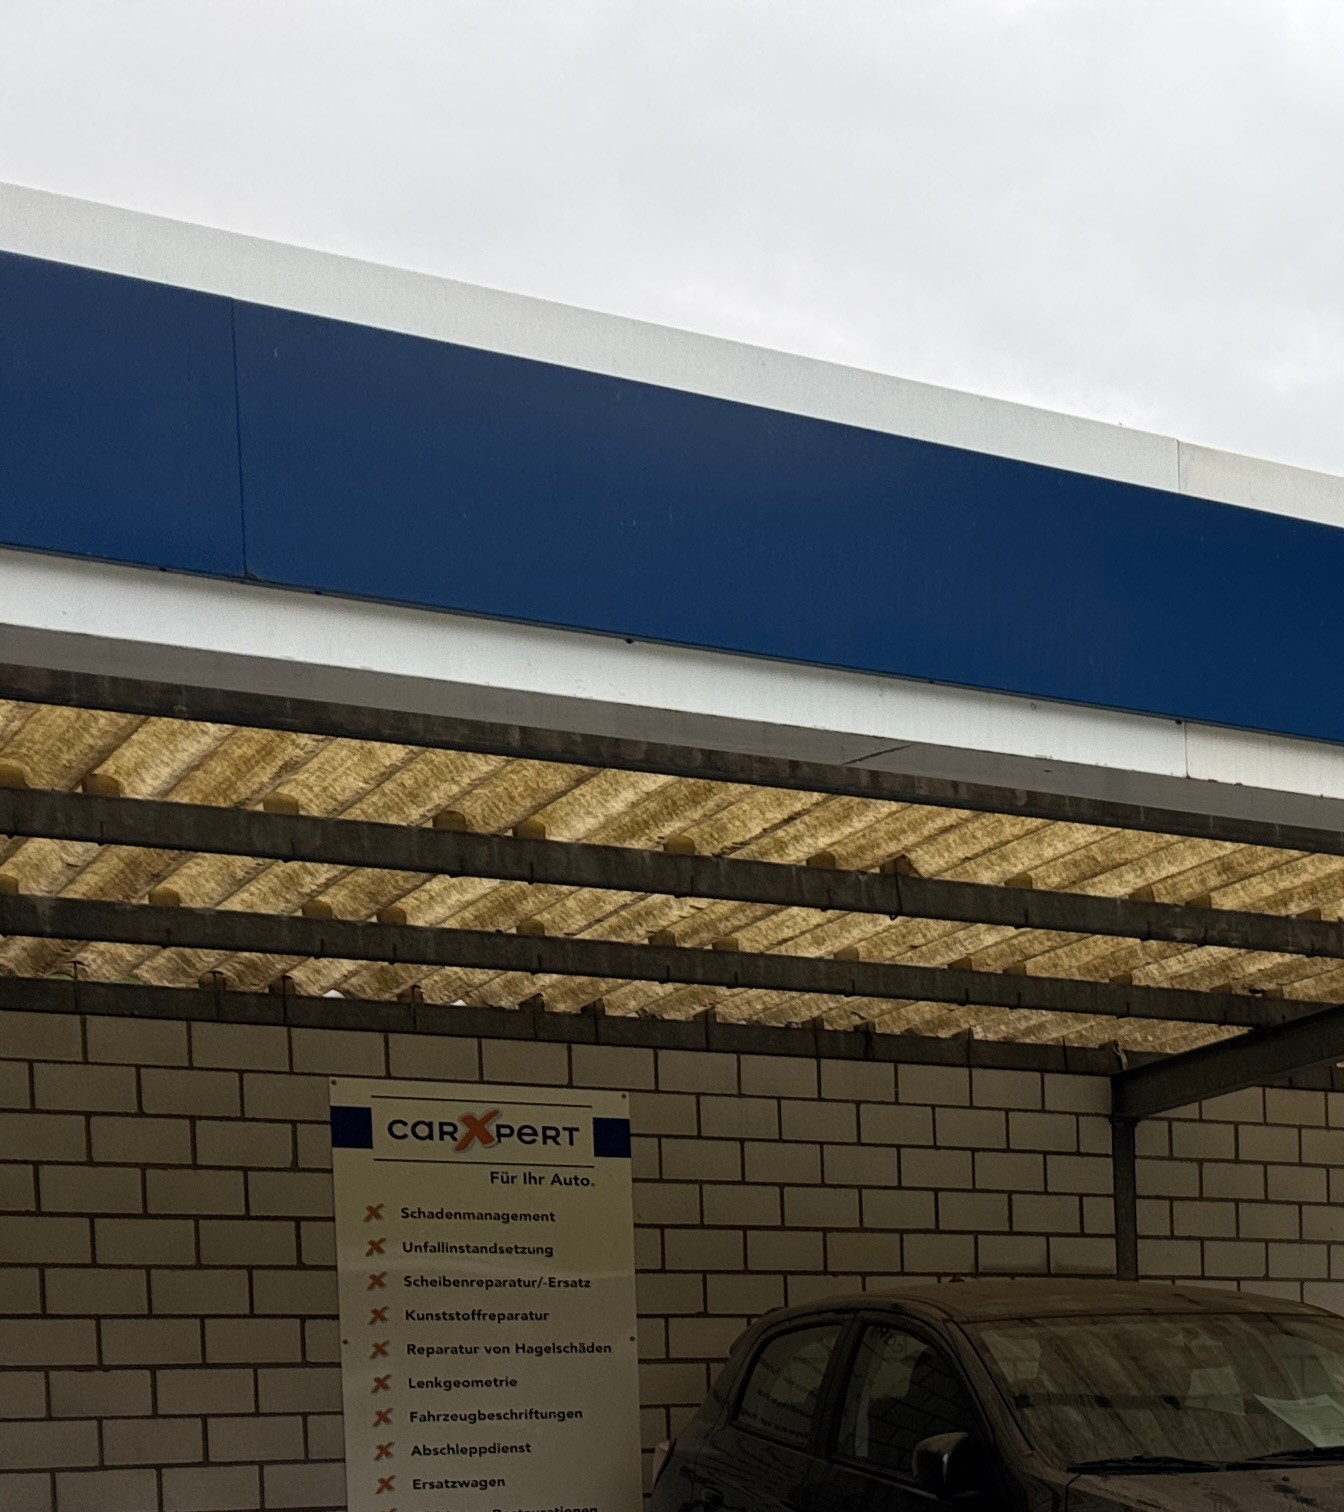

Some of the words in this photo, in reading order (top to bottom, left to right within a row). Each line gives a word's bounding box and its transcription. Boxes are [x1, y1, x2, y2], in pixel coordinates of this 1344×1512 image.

[489, 1170, 518, 1185] Für
[522, 1171, 546, 1185] Ihr
[550, 1172, 596, 1187] Auto.
[400, 1207, 556, 1224] Schadenmanagement
[402, 1241, 554, 1258] Unfallinstandsetzung
[403, 1275, 592, 1291] Scheibenreparatur/-Ersatz
[404, 1308, 551, 1324] Kunststoffreparatur
[406, 1343, 480, 1358] Reparatur
[484, 1344, 511, 1355] von
[514, 1341, 613, 1357] Hagelschäden
[407, 1375, 519, 1391] Lenkgeometrie
[409, 1407, 584, 1423] Fahrzeugbeschriftungen
[410, 1442, 532, 1457] Abschleppdienst
[412, 1476, 506, 1491] Ersatzwagen
